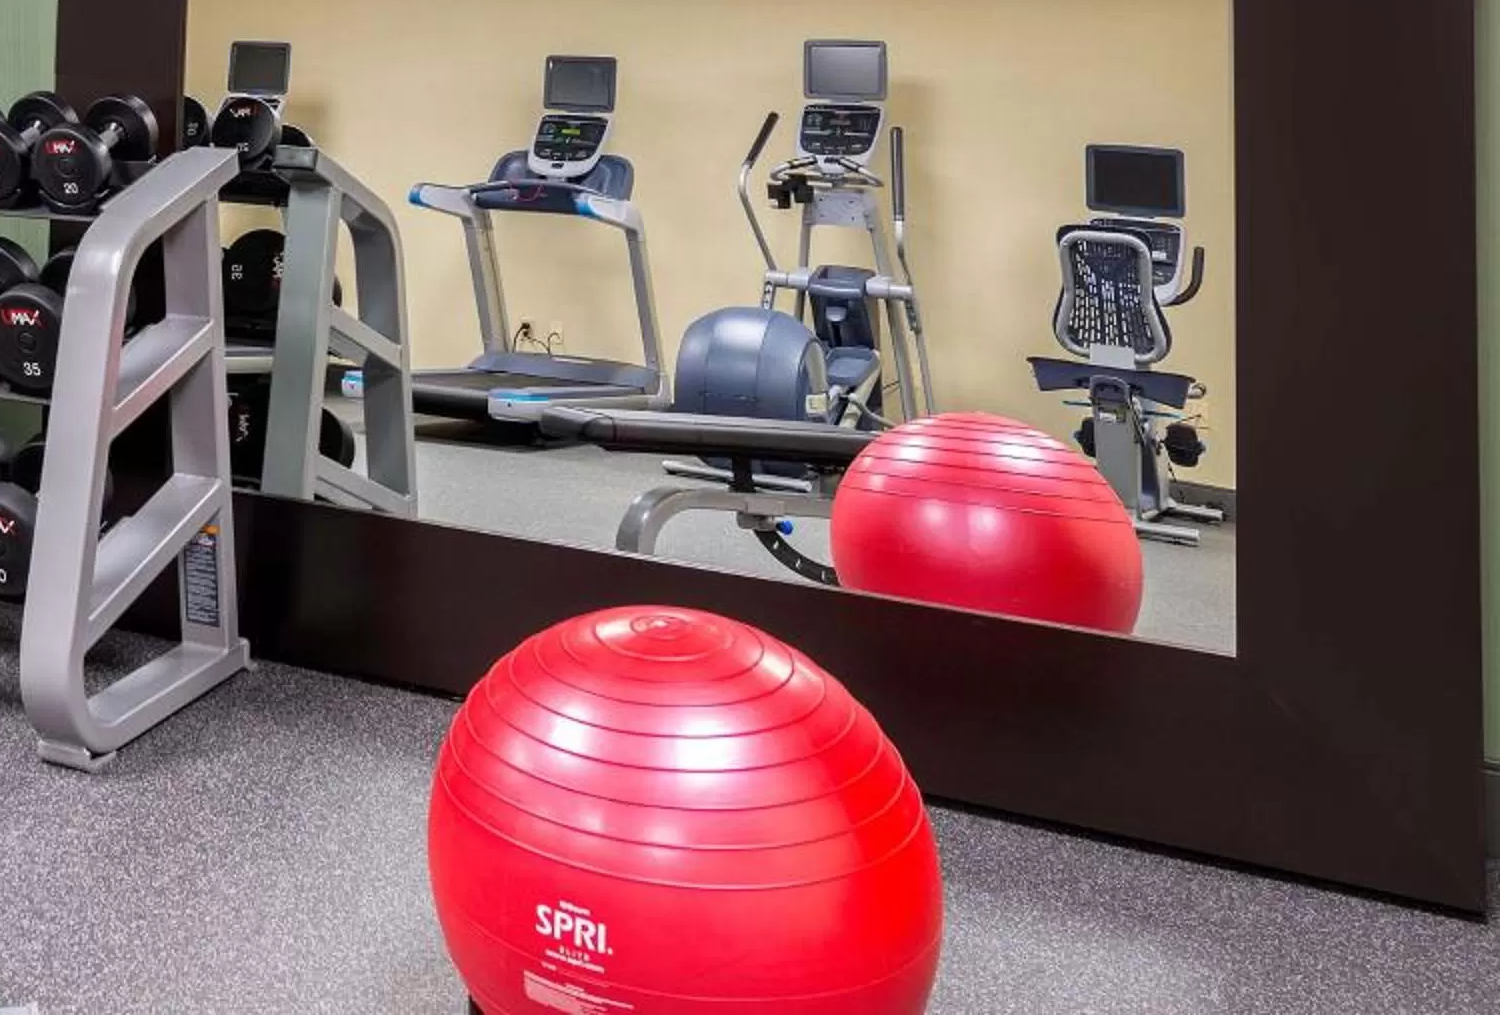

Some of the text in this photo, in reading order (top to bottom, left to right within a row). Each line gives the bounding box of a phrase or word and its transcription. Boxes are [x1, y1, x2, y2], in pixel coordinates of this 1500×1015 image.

[63, 182, 79, 194] 20
[0, 308, 45, 329] UMAX
[23, 362, 41, 376] 35
